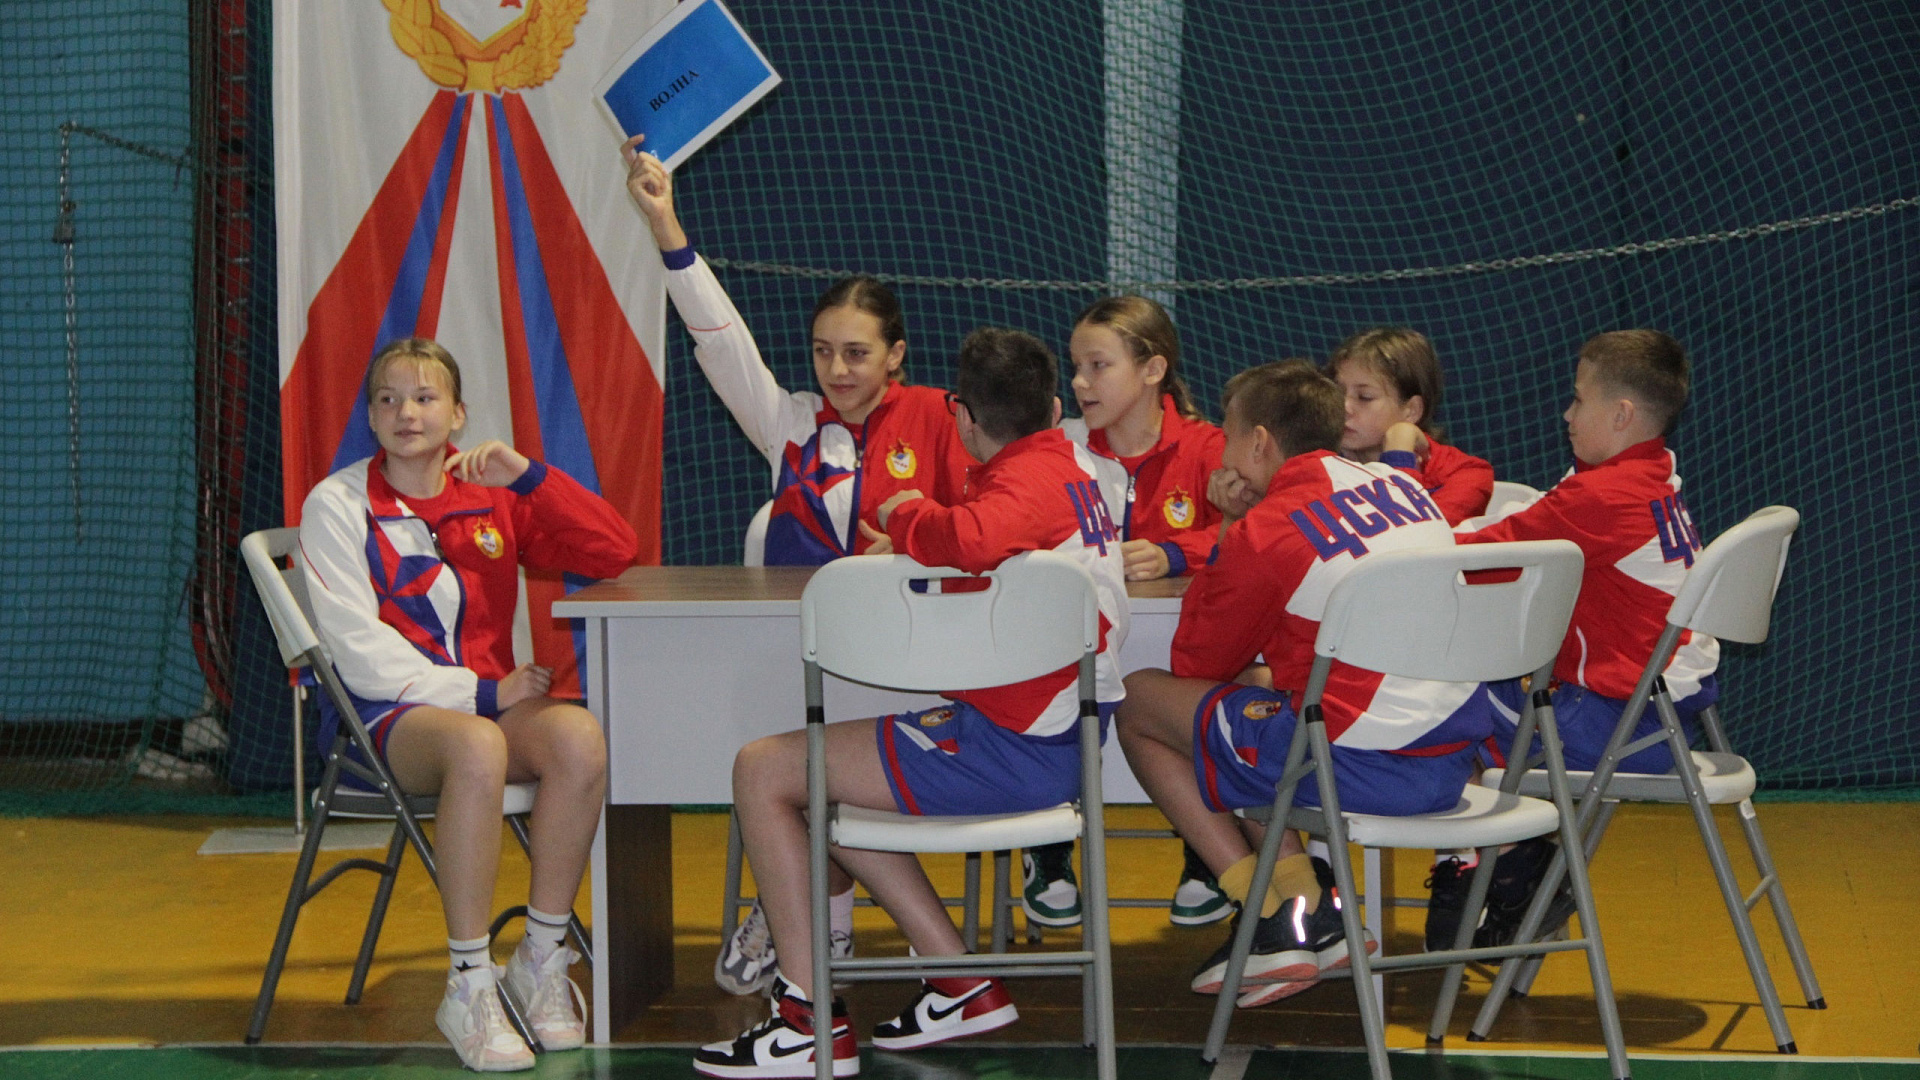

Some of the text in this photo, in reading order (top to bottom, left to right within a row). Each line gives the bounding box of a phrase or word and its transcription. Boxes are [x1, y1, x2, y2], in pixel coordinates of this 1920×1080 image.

[648, 69, 699, 112] ВОЛНА
[1064, 479, 1119, 557] ЦС
[1288, 474, 1443, 562] ЦСКА
[1649, 490, 1701, 570] ЦС
